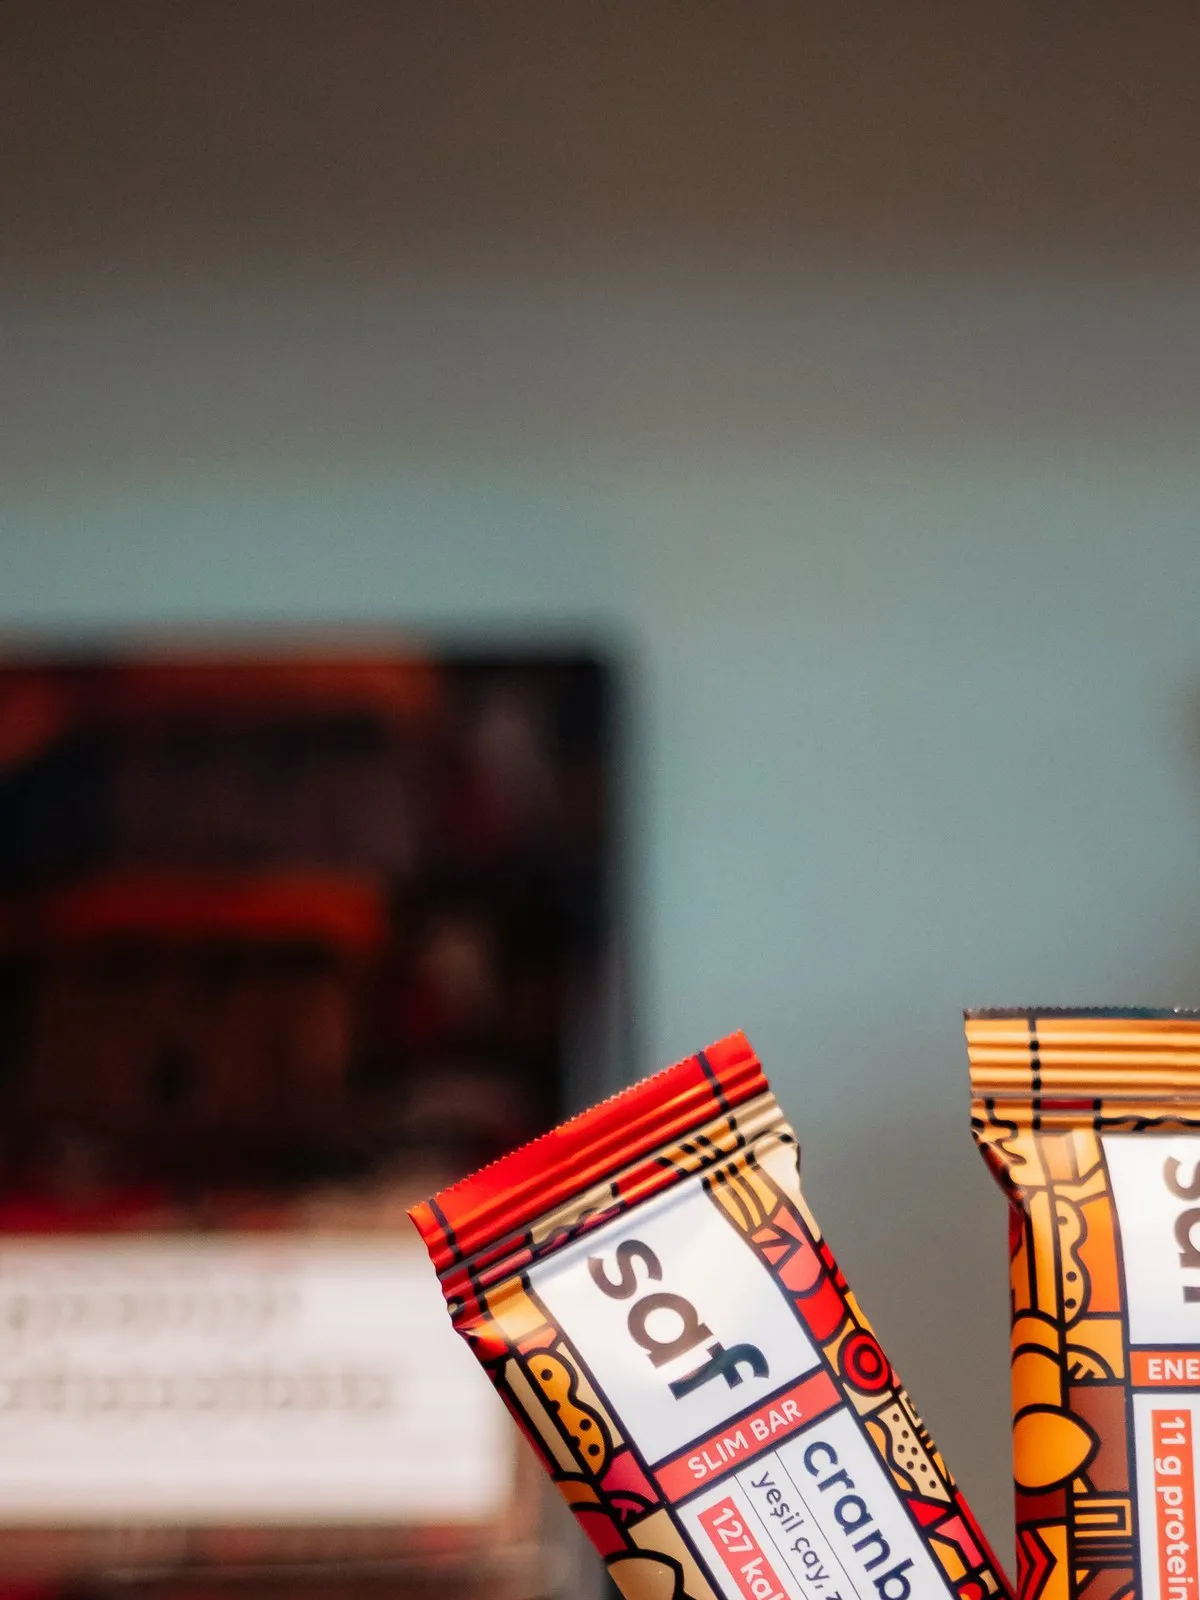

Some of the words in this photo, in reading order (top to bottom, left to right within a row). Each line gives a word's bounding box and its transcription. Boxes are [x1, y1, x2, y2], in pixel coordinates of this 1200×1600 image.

[587, 1239, 770, 1402] saf
[687, 1431, 749, 1479] SLIM
[750, 1399, 803, 1442] BAR
[1160, 1416, 1186, 1446] 11
[1154, 1456, 1183, 1476] g
[712, 1507, 750, 1554] 127
[751, 1471, 804, 1534] yeşil
[790, 1536, 830, 1589] çay,
